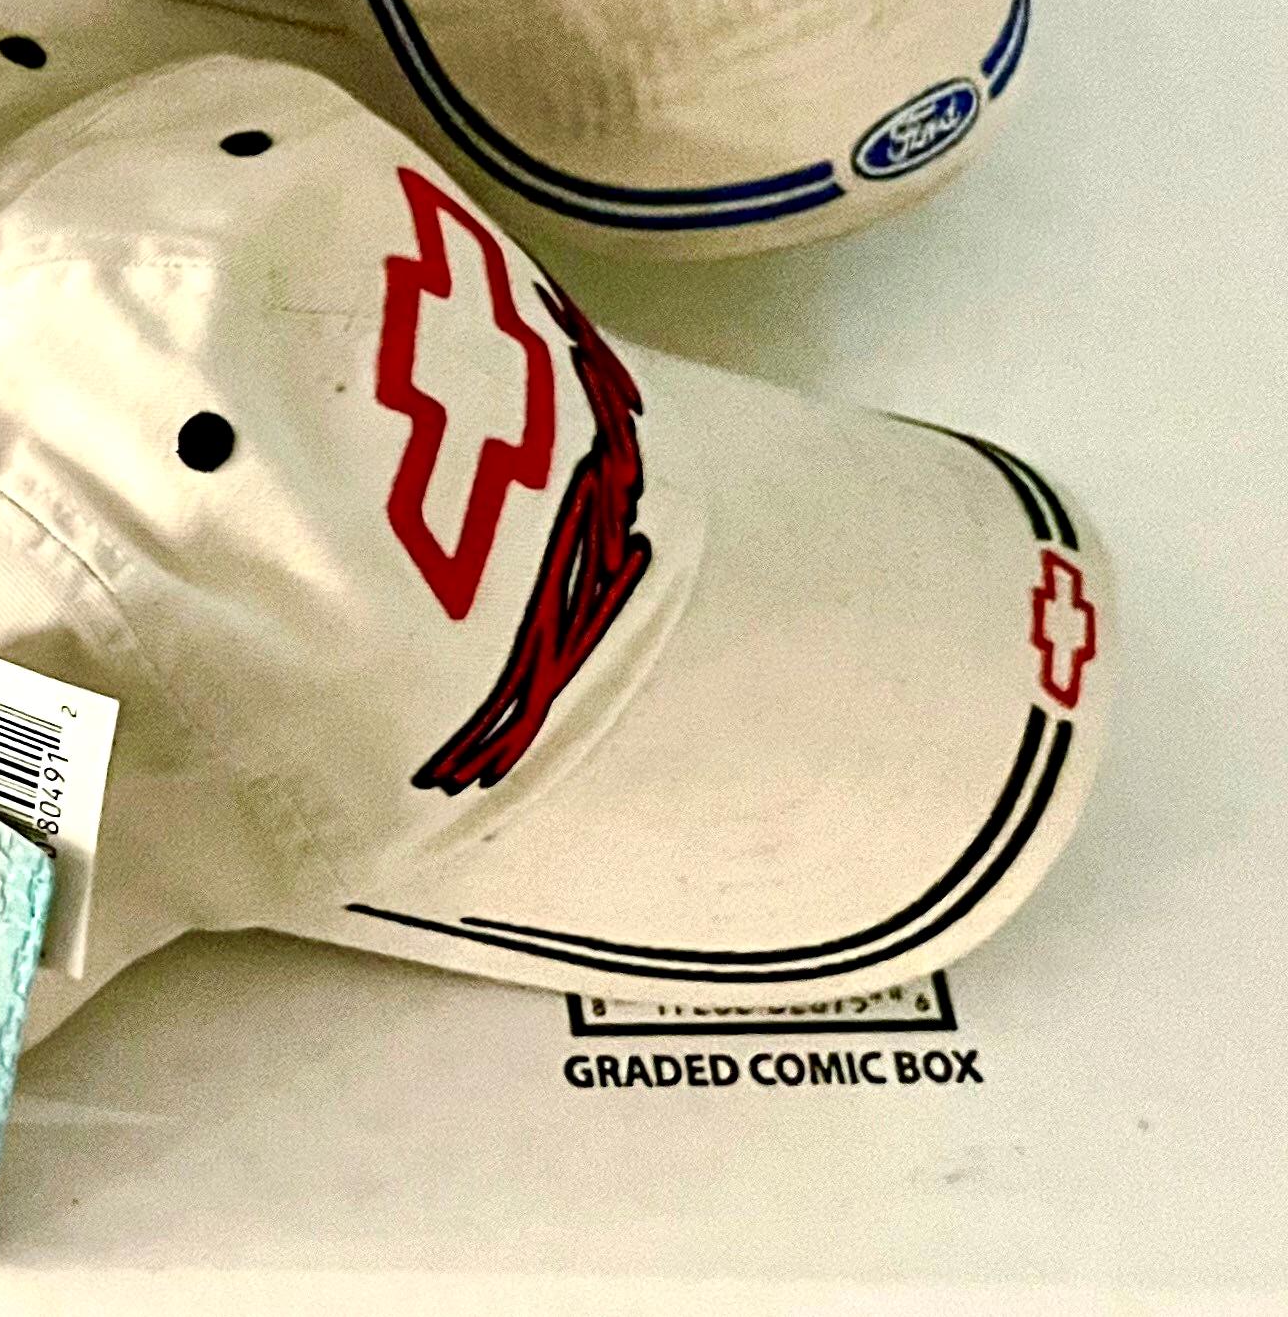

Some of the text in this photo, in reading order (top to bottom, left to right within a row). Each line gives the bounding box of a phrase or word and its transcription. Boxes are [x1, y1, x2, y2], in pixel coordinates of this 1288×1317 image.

[887, 97, 962, 163] Ford
[563, 1048, 985, 1089] GRADED COMIC BOX
